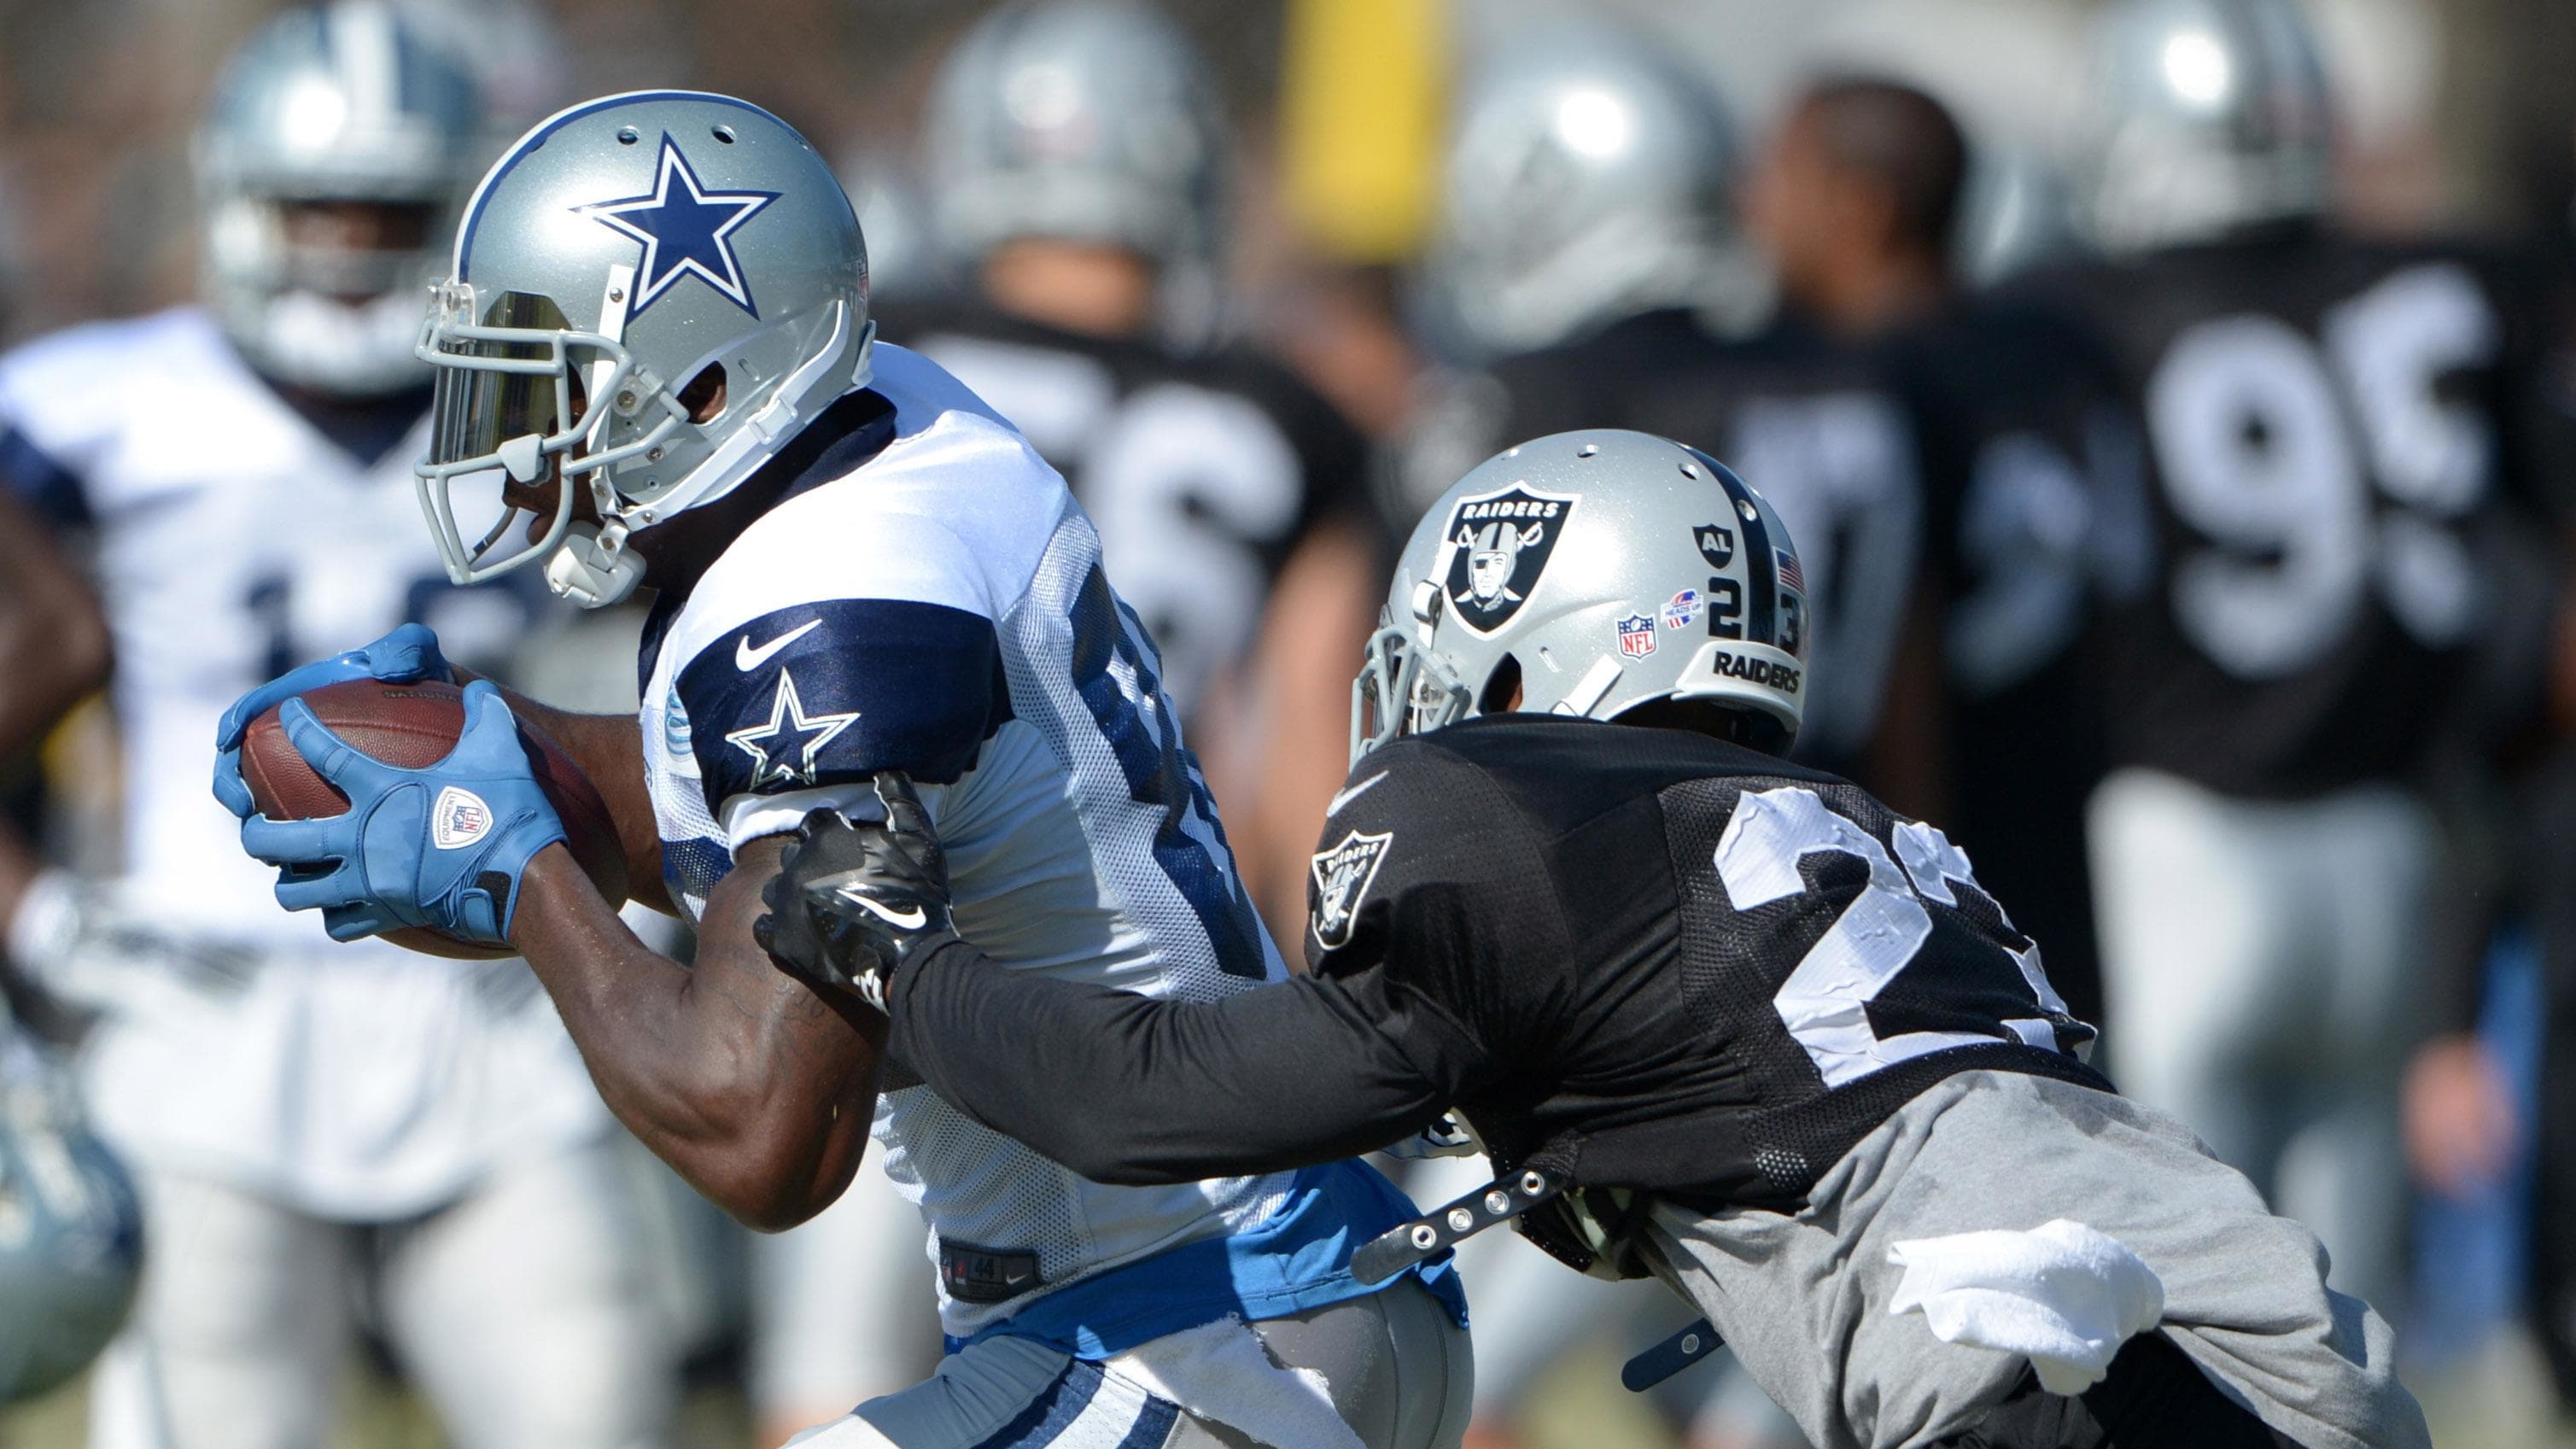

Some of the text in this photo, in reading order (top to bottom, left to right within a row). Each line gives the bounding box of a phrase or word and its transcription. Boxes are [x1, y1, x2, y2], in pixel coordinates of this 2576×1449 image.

[1462, 501, 1560, 519] RAIDERS
[1702, 532, 1732, 552] AL
[1621, 633, 1655, 655] NFL
[1713, 651, 1801, 694] RAIDERS
[441, 795, 458, 841] EQUIPMENT
[464, 811, 481, 832] NFL
